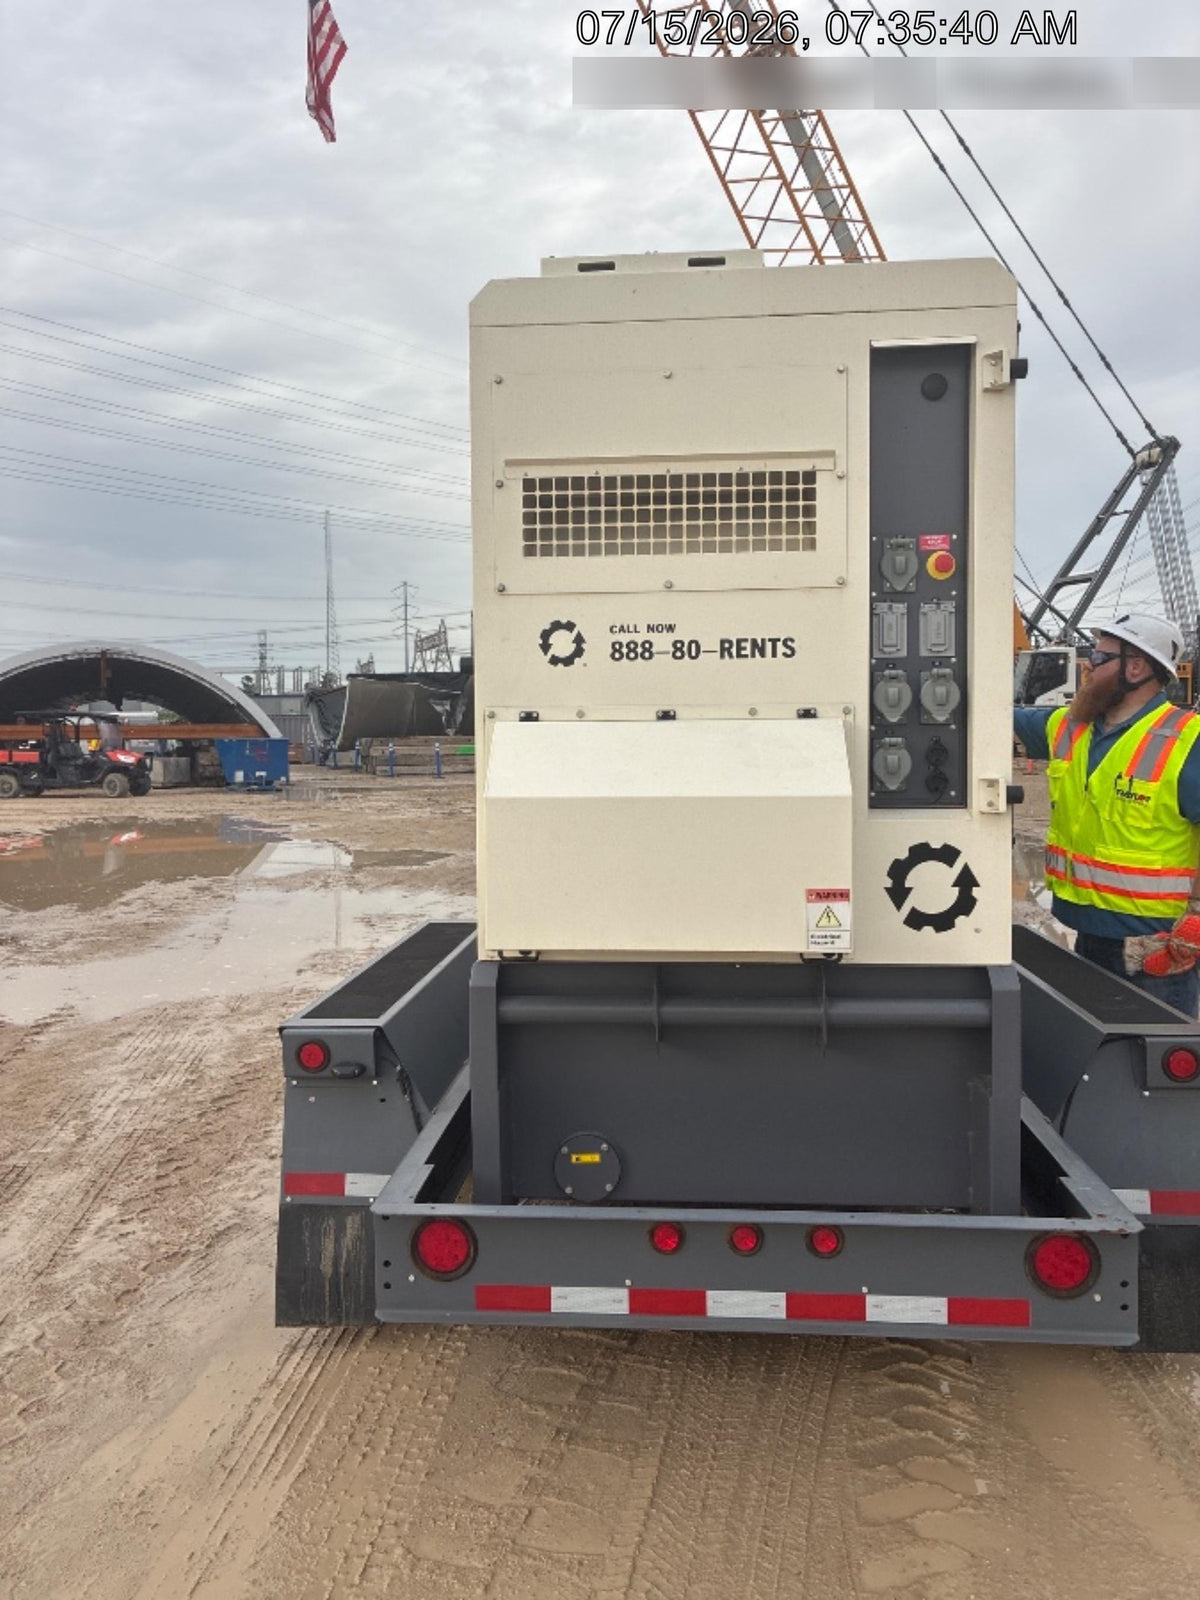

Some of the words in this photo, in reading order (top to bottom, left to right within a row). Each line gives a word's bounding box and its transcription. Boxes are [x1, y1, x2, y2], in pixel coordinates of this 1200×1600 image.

[609, 624, 640, 634] CALL
[647, 623, 676, 633] NOW
[609, 636, 796, 661] 888-80-RENTS
